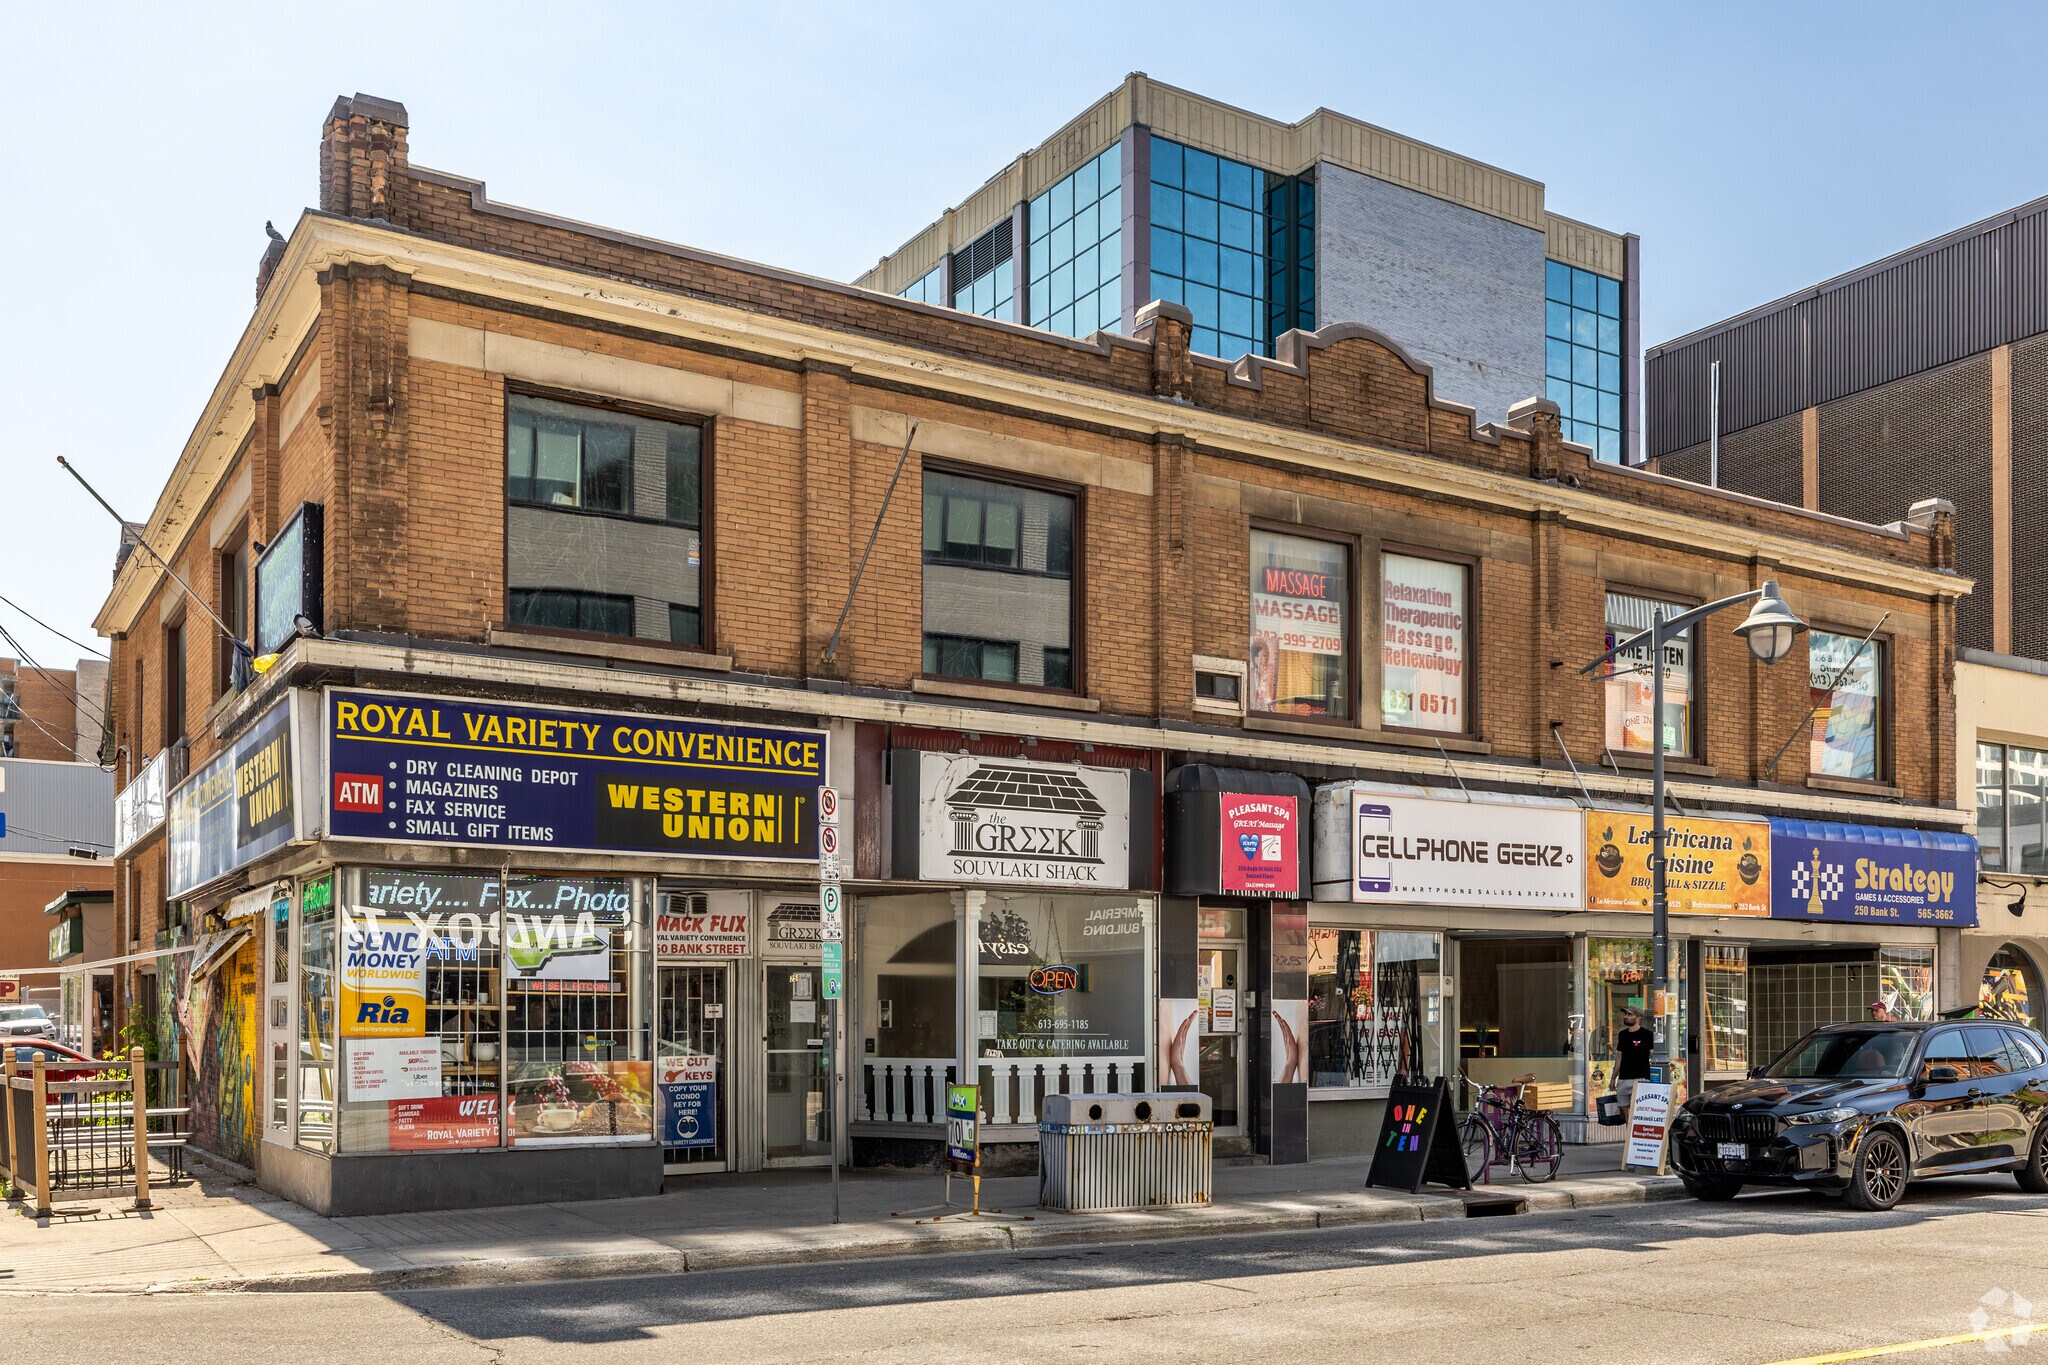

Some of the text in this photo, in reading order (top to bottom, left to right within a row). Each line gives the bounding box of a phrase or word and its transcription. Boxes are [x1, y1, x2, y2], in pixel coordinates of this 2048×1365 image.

[1265, 568, 1326, 598] MASSAGE
[1383, 580, 1452, 607] Relaxation
[1254, 597, 1339, 624] MASSAGE
[1383, 601, 1463, 631] Therapeutic
[1384, 624, 1458, 654] Massage,
[1384, 646, 1463, 677] Reflexology
[1663, 645, 1684, 667] TEN
[1419, 692, 1457, 715] 0571
[336, 701, 820, 769] ROYAL VARIETY CONVENIENCE
[236, 739, 279, 799] WESTERN
[406, 759, 579, 786] DRY CLEANING DEPOT
[339, 782, 379, 806] ATM
[406, 779, 499, 800] MAGAZINES
[249, 777, 281, 828] UNION
[406, 799, 507, 820] FAX SERVICE
[607, 783, 776, 818] WESTERN
[989, 811, 1007, 825] the
[1228, 803, 1290, 820] PLEASANT SPA
[406, 818, 554, 842] SMALL GIFT ITEMS
[662, 813, 776, 844] UNION
[1627, 825, 1733, 850] La fricana
[1362, 835, 1563, 867] CELLPHONE GEEKZ
[953, 859, 1097, 881] SOUVLAKI SHACK
[1646, 853, 1714, 875] Cisine
[1394, 885, 1472, 894] SMARTPHONE
[1683, 881, 1691, 889] &
[1692, 881, 1726, 891] SIZZLE
[1855, 858, 1954, 903] Strategy
[827, 893, 834, 906] P
[1738, 903, 1748, 911] 252
[1855, 892, 1925, 905] GAMES & ACCESSORIES
[1854, 905, 1954, 920] 250 Bank St. 565-3662
[656, 914, 746, 933] NACK FLIX
[348, 929, 421, 952] SEND
[425, 937, 477, 961] ATM
[671, 944, 702, 954] BANK
[706, 944, 746, 954] STREET
[769, 942, 807, 950] SOUVLAKI
[347, 952, 421, 969] MONEY
[347, 968, 420, 980] WORLDWIDE
[1030, 969, 1077, 989] OPEN
[0, 982, 15, 997] P
[357, 998, 410, 1024] Ria
[350, 1026, 416, 1034] riamoneytransfer.com
[1038, 1019, 1089, 1030] 613-695-1185
[996, 1039, 1129, 1051] TAKE OUT & CATERING AVAILABLE
[665, 1058, 709, 1067] WE CUT
[685, 1071, 713, 1080] KEYS
[1636, 1093, 1661, 1105] PLEASANT
[487, 1117, 498, 1125] TO
[1394, 1105, 1427, 1124] ONE
[427, 1130, 454, 1140] ROYAL
[456, 1127, 491, 1137] VARIETY
[1402, 1123, 1410, 1132] IN
[1386, 1131, 1419, 1151] TEN
